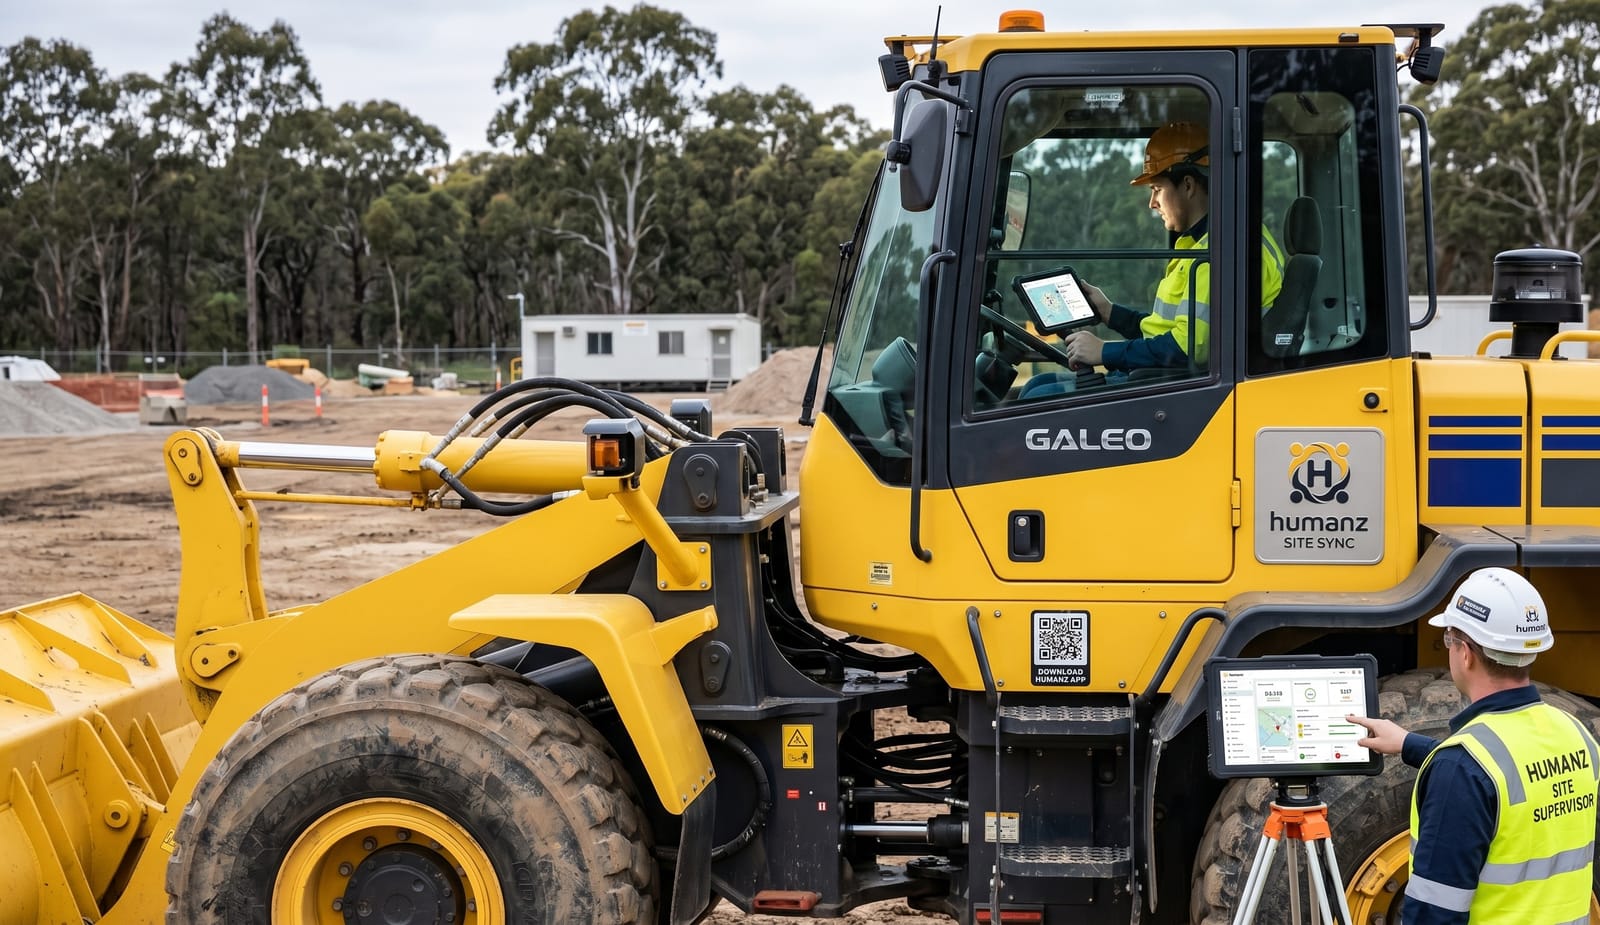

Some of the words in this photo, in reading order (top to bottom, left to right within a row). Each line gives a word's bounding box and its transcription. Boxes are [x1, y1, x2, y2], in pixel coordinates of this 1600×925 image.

[1025, 428, 1152, 451] GALEO
[1306, 459, 1333, 488] H
[1270, 510, 1369, 532] humanz
[1284, 537, 1314, 549] SITE
[1317, 537, 1355, 549] SYNC
[1525, 749, 1589, 784] HUMANZ
[1552, 779, 1575, 798] SITE
[1533, 793, 1594, 823] SUPERVISOR
